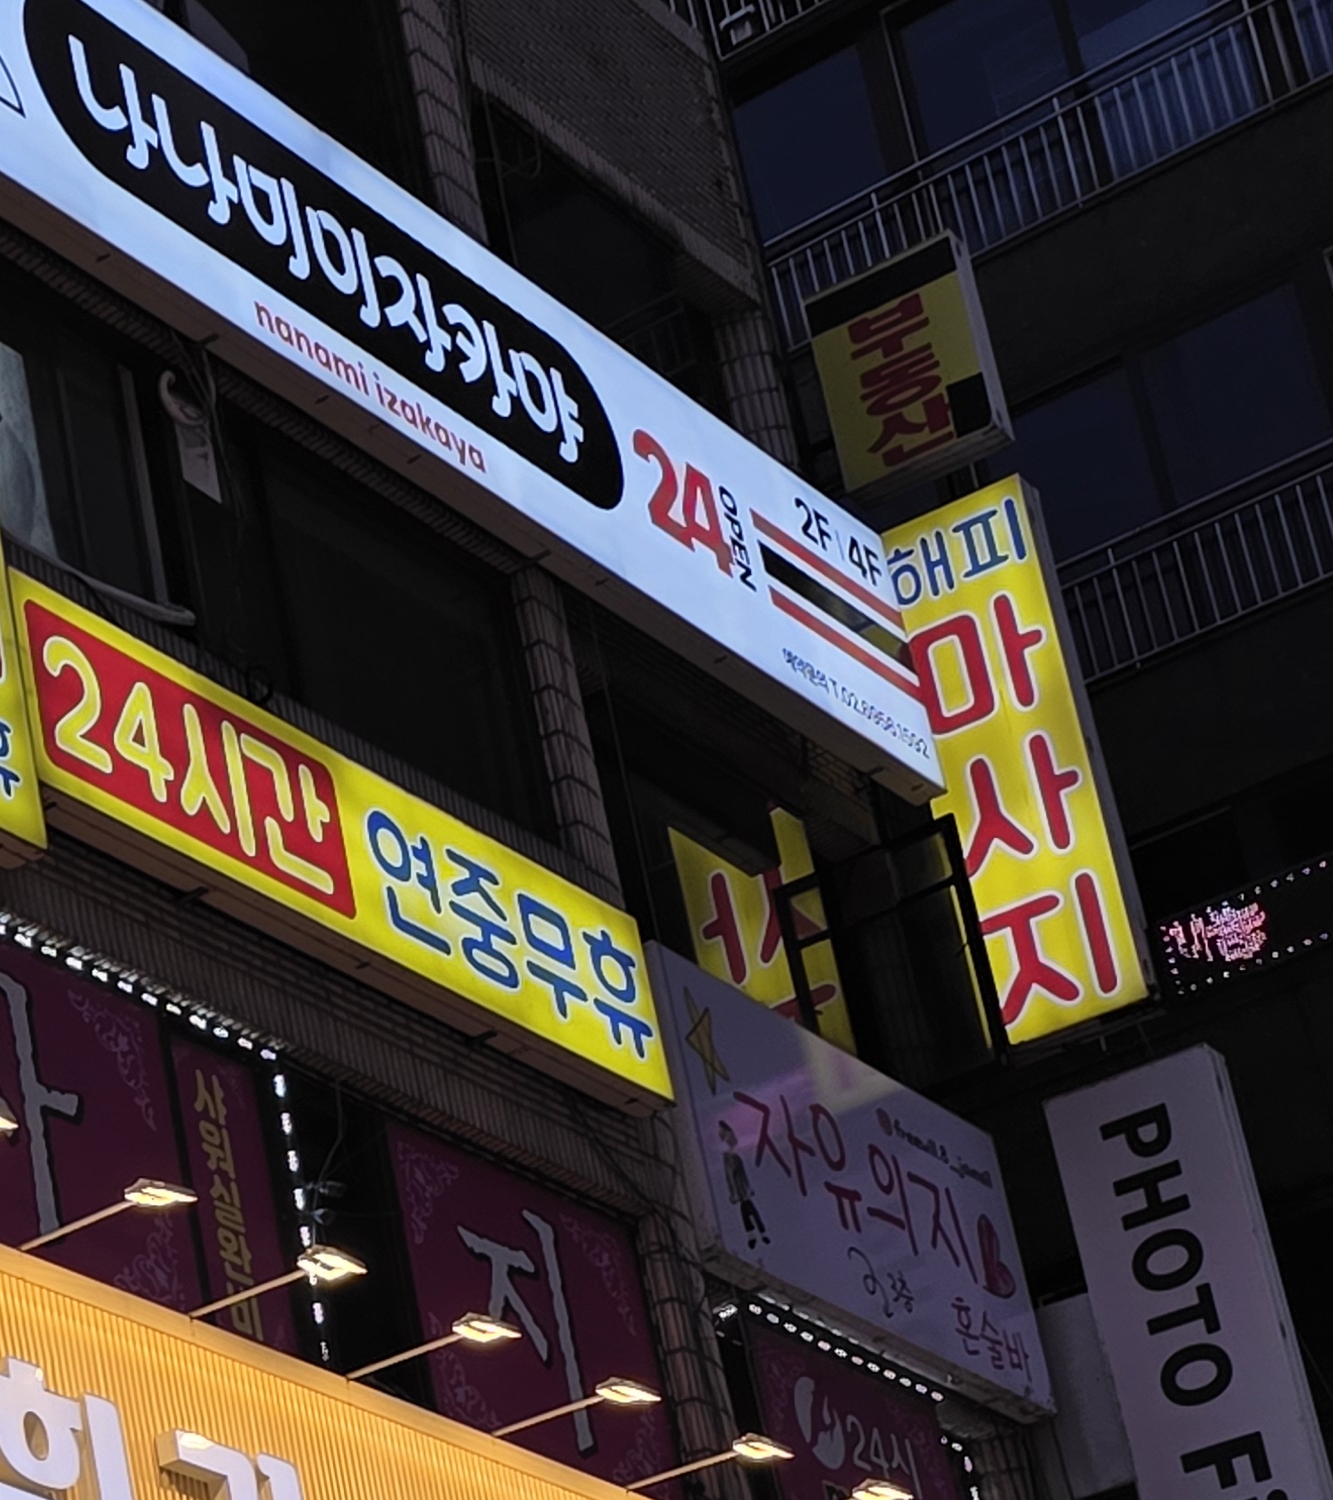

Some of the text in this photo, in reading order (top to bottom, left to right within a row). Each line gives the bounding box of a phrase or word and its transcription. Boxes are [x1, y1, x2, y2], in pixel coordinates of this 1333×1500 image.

[253, 299, 488, 474] nanami izakaya
[846, 291, 957, 469] 부동산
[632, 428, 735, 576] 24
[718, 484, 757, 594] OPEN
[793, 497, 883, 587] 2F 4F
[885, 498, 1028, 608] 해피
[41, 635, 334, 896] 24시간
[905, 592, 1119, 1029] 마사지
[365, 808, 655, 1060] 연중무휴
[733, 1090, 979, 1285] 자유의지
[1098, 1102, 1234, 1409] PHOTO
[951, 1296, 1031, 1382] 혼술바
